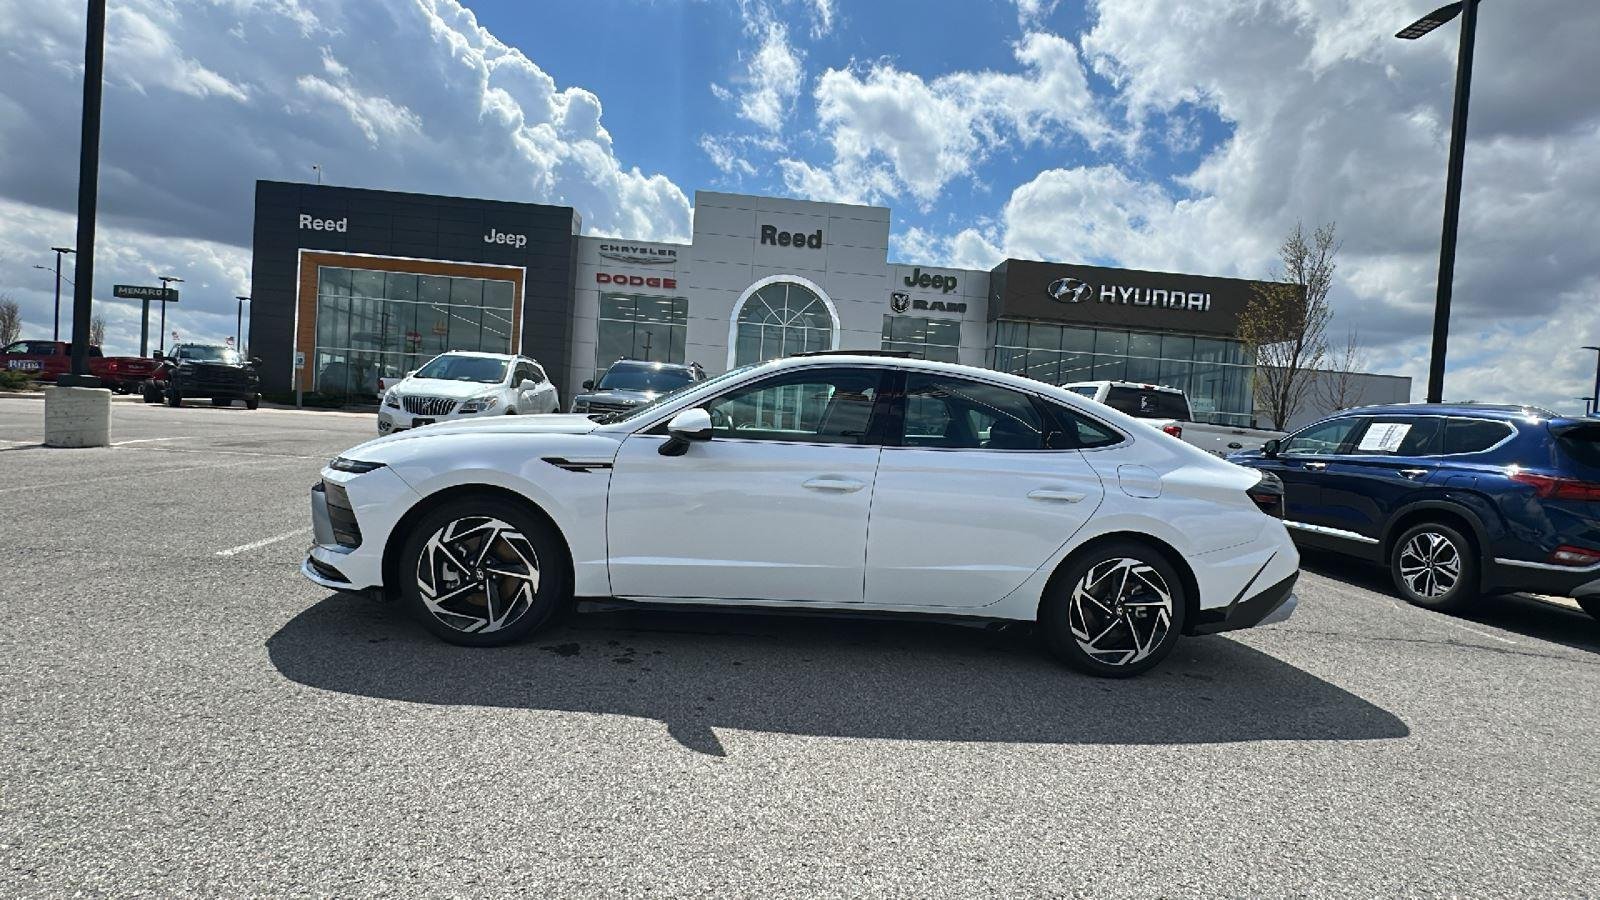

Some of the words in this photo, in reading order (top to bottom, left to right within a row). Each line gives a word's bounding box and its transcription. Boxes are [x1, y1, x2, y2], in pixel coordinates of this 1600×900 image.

[299, 213, 348, 233] Reed
[484, 228, 527, 248] Jeep
[760, 224, 823, 249] Reed
[600, 244, 677, 257] CHRYSLER
[596, 272, 677, 289] DODGE
[904, 267, 957, 294] Jeep
[912, 299, 967, 314] RAM
[1099, 284, 1211, 312] HYUNDAI
